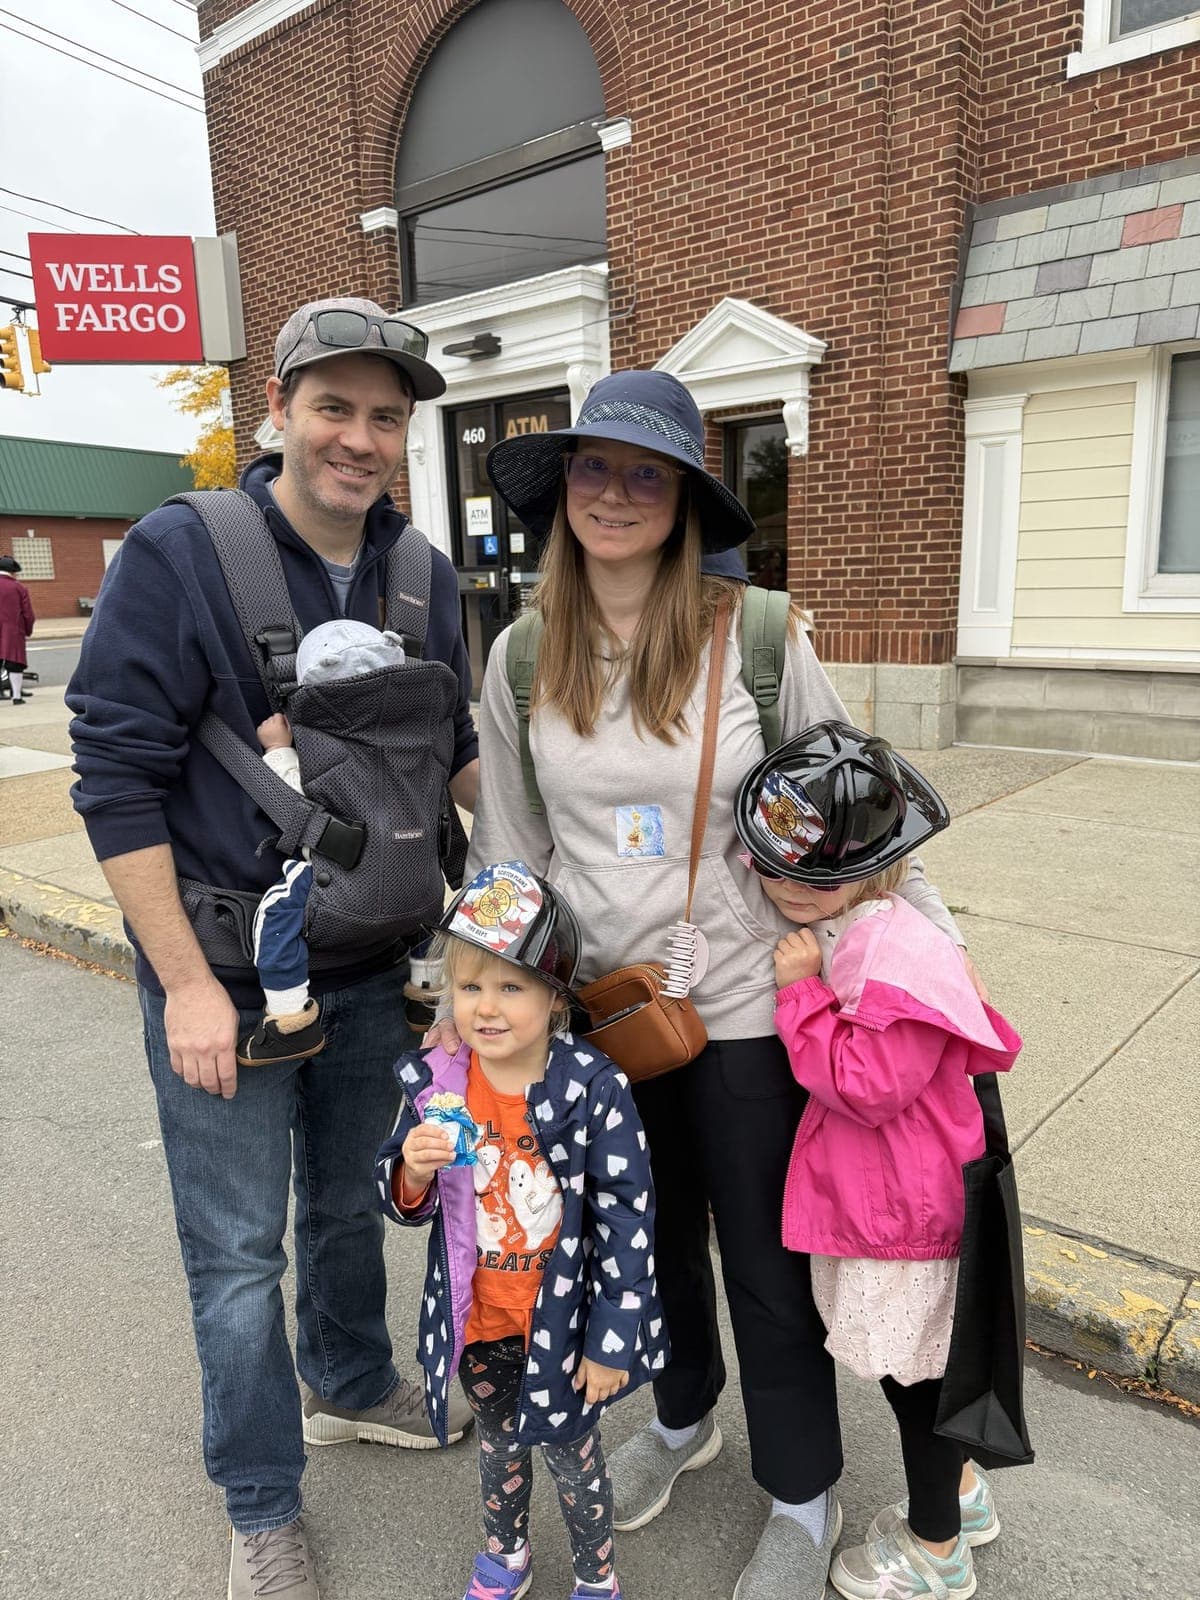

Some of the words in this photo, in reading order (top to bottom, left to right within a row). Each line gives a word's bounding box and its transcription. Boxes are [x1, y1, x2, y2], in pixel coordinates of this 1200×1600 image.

[45, 263, 182, 294] WELLS
[54, 303, 186, 333] FARGO
[462, 427, 486, 444] 460
[506, 414, 548, 439] ATM
[471, 509, 488, 520] ATM
[476, 1245, 554, 1272] REATS
